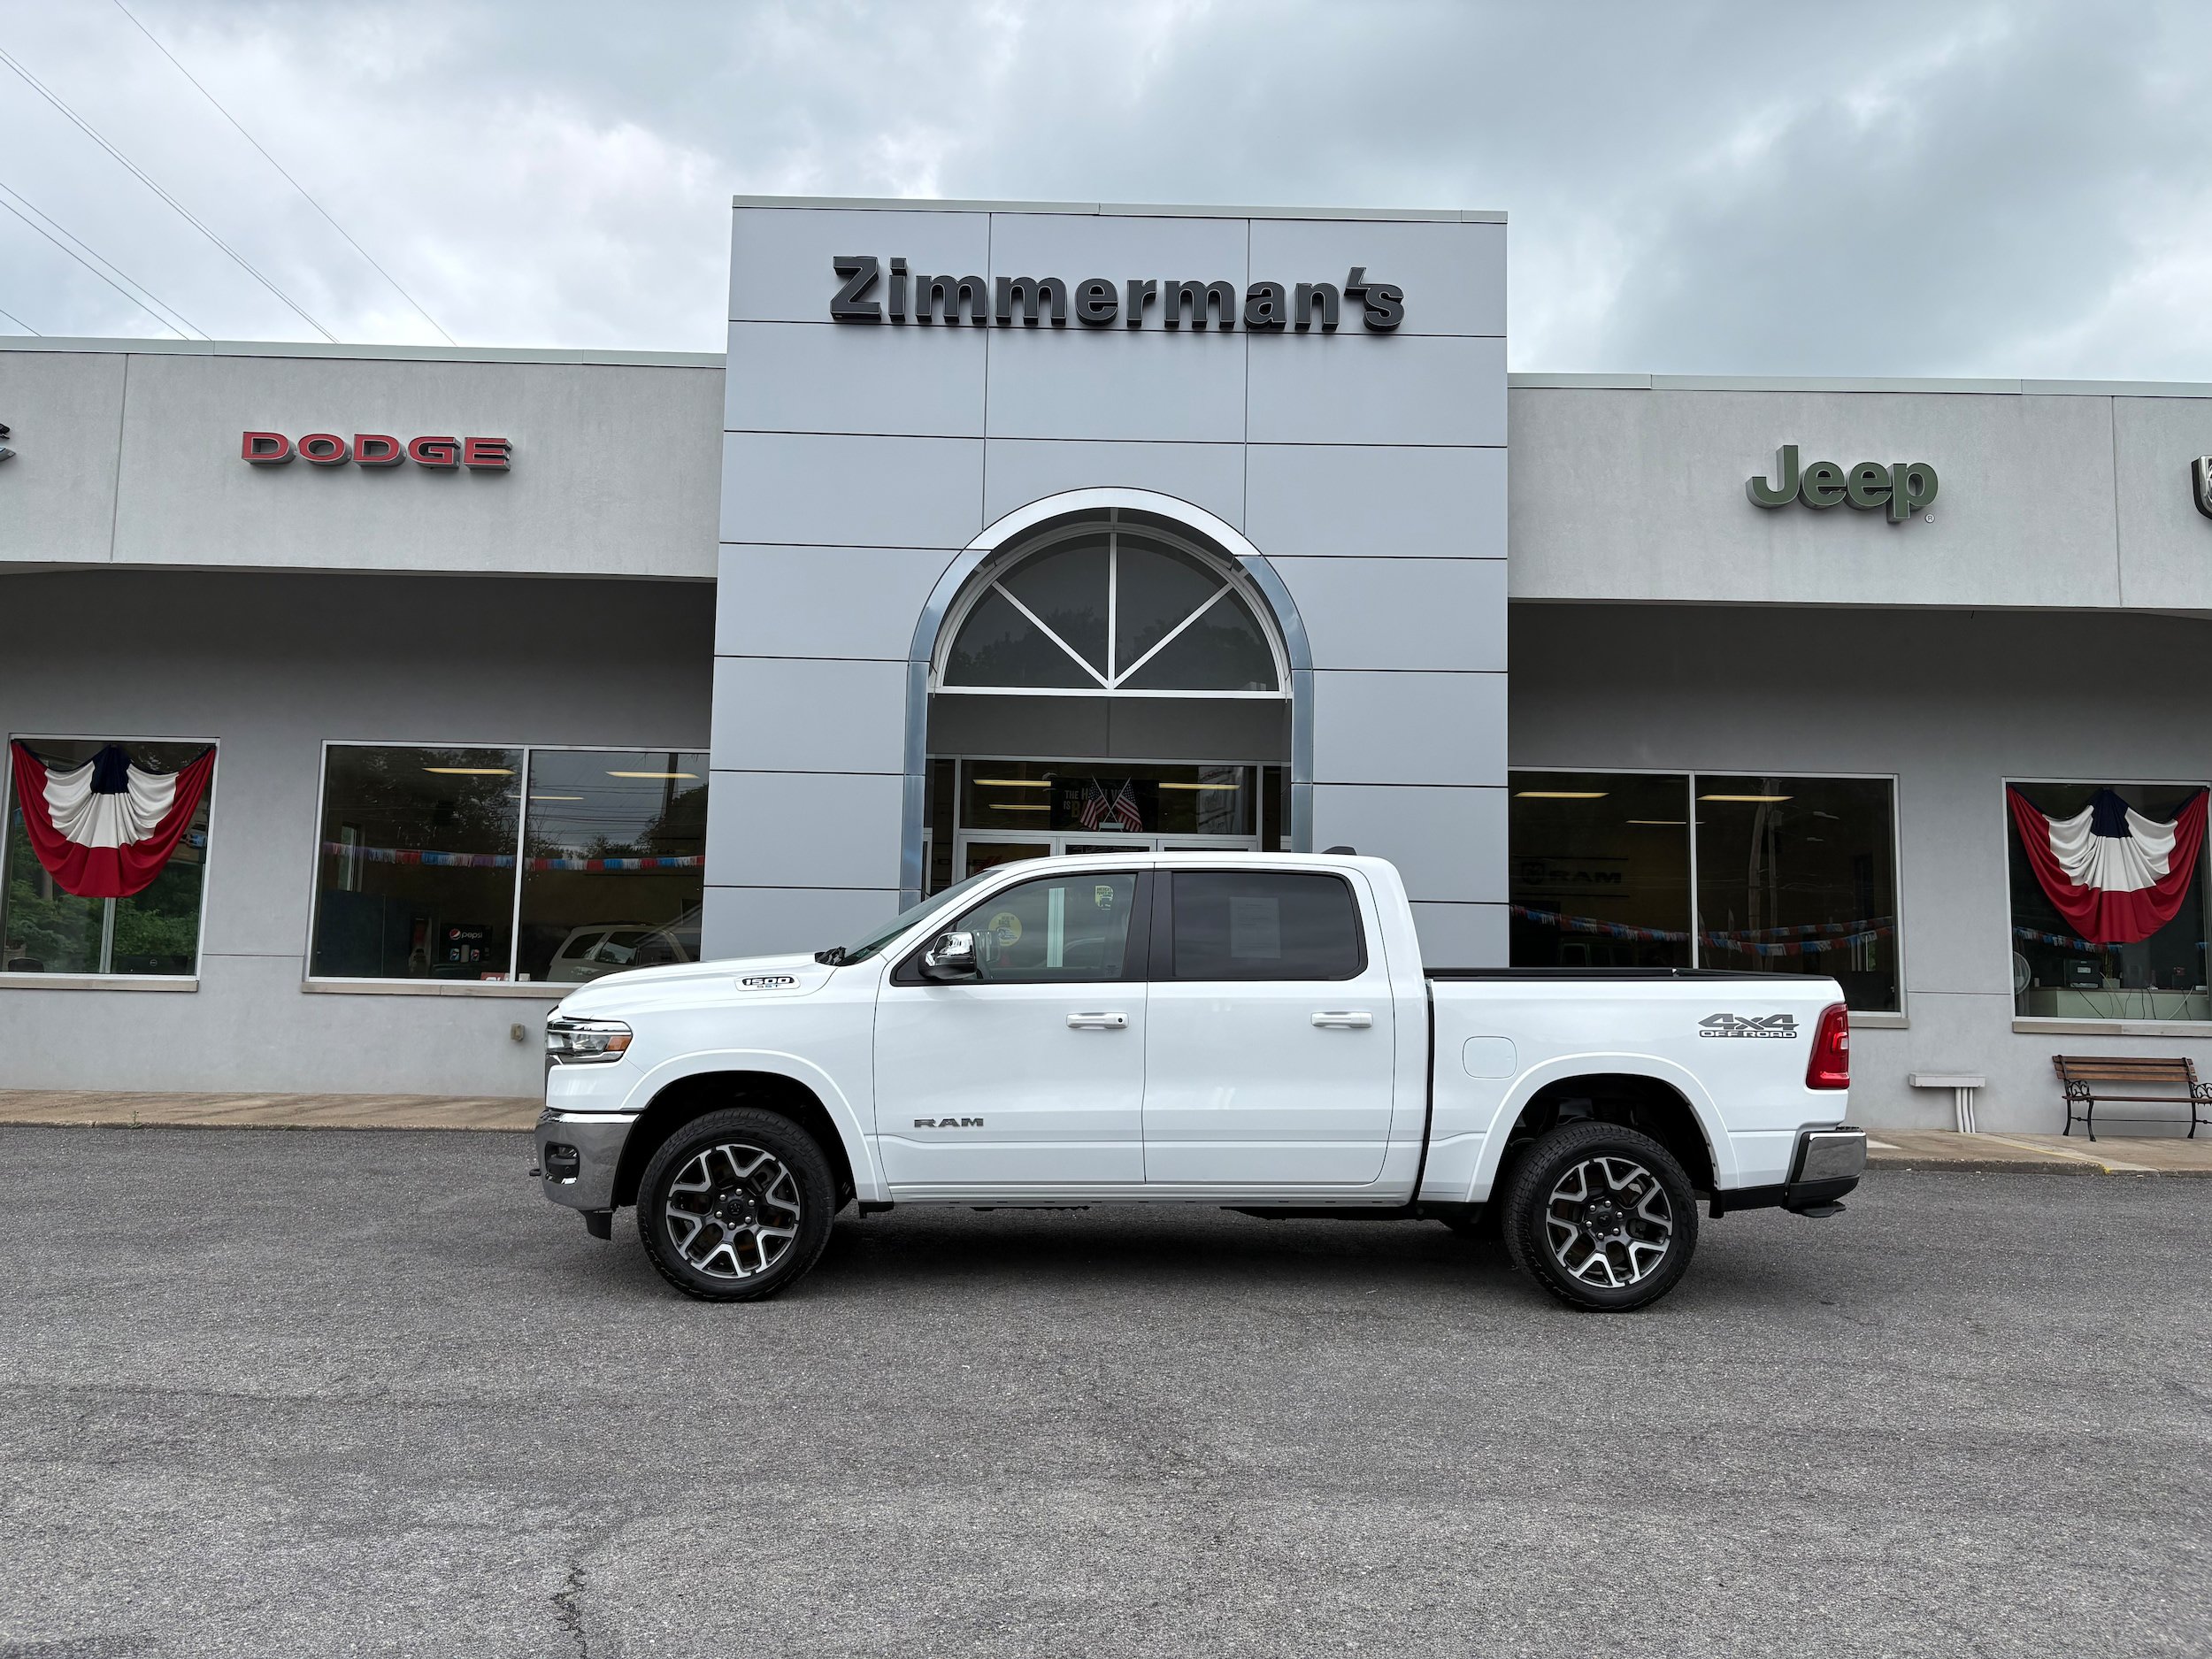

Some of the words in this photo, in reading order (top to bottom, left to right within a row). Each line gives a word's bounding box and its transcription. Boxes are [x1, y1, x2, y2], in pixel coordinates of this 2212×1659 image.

[830, 256, 1404, 333] Zimmerman's
[242, 430, 512, 472] DODGE
[1746, 444, 1939, 524] Jeep
[1064, 789, 1079, 800] THE
[1063, 800, 1071, 810] IS
[1549, 870, 1622, 884] RAM
[461, 931, 483, 940] pepsi
[745, 976, 791, 986] 1500
[1698, 1012, 1800, 1031] 4x4
[1742, 1030, 1796, 1039] ROAD
[914, 1118, 984, 1128] RAM
